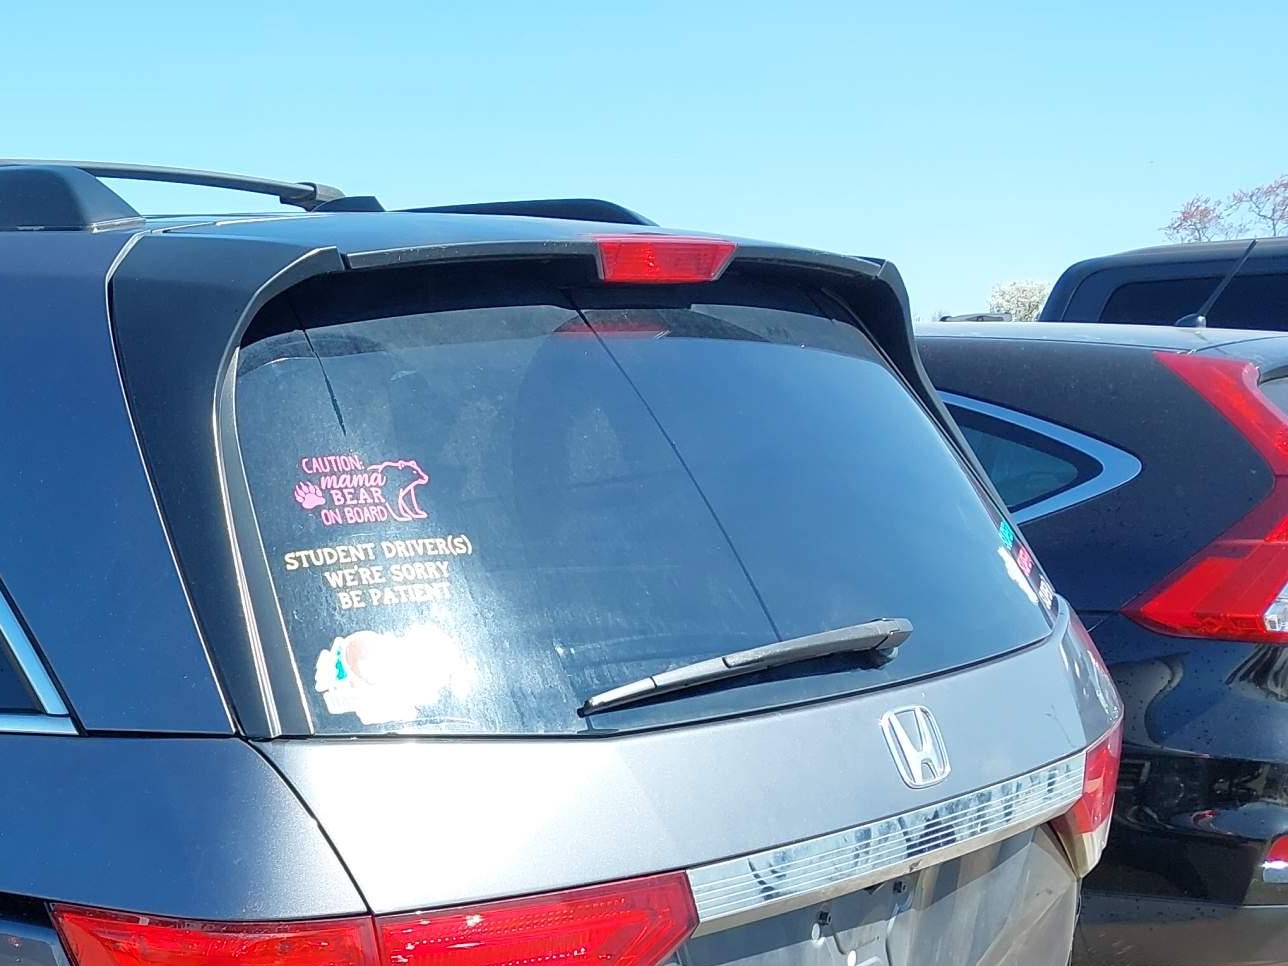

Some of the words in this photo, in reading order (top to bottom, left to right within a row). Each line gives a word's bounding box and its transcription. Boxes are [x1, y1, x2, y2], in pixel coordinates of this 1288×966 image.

[301, 455, 365, 474] CAUTION:
[320, 471, 386, 489] mama
[331, 487, 386, 506] BEAR
[321, 509, 343, 526] ON
[345, 505, 388, 524] BOARD
[284, 543, 376, 571] STUDENT
[382, 534, 473, 560] DRIVER(S)
[325, 565, 385, 588] WE'RE
[390, 560, 450, 582] SORRY
[338, 590, 366, 610] BE
[369, 582, 452, 607] PATIENT
